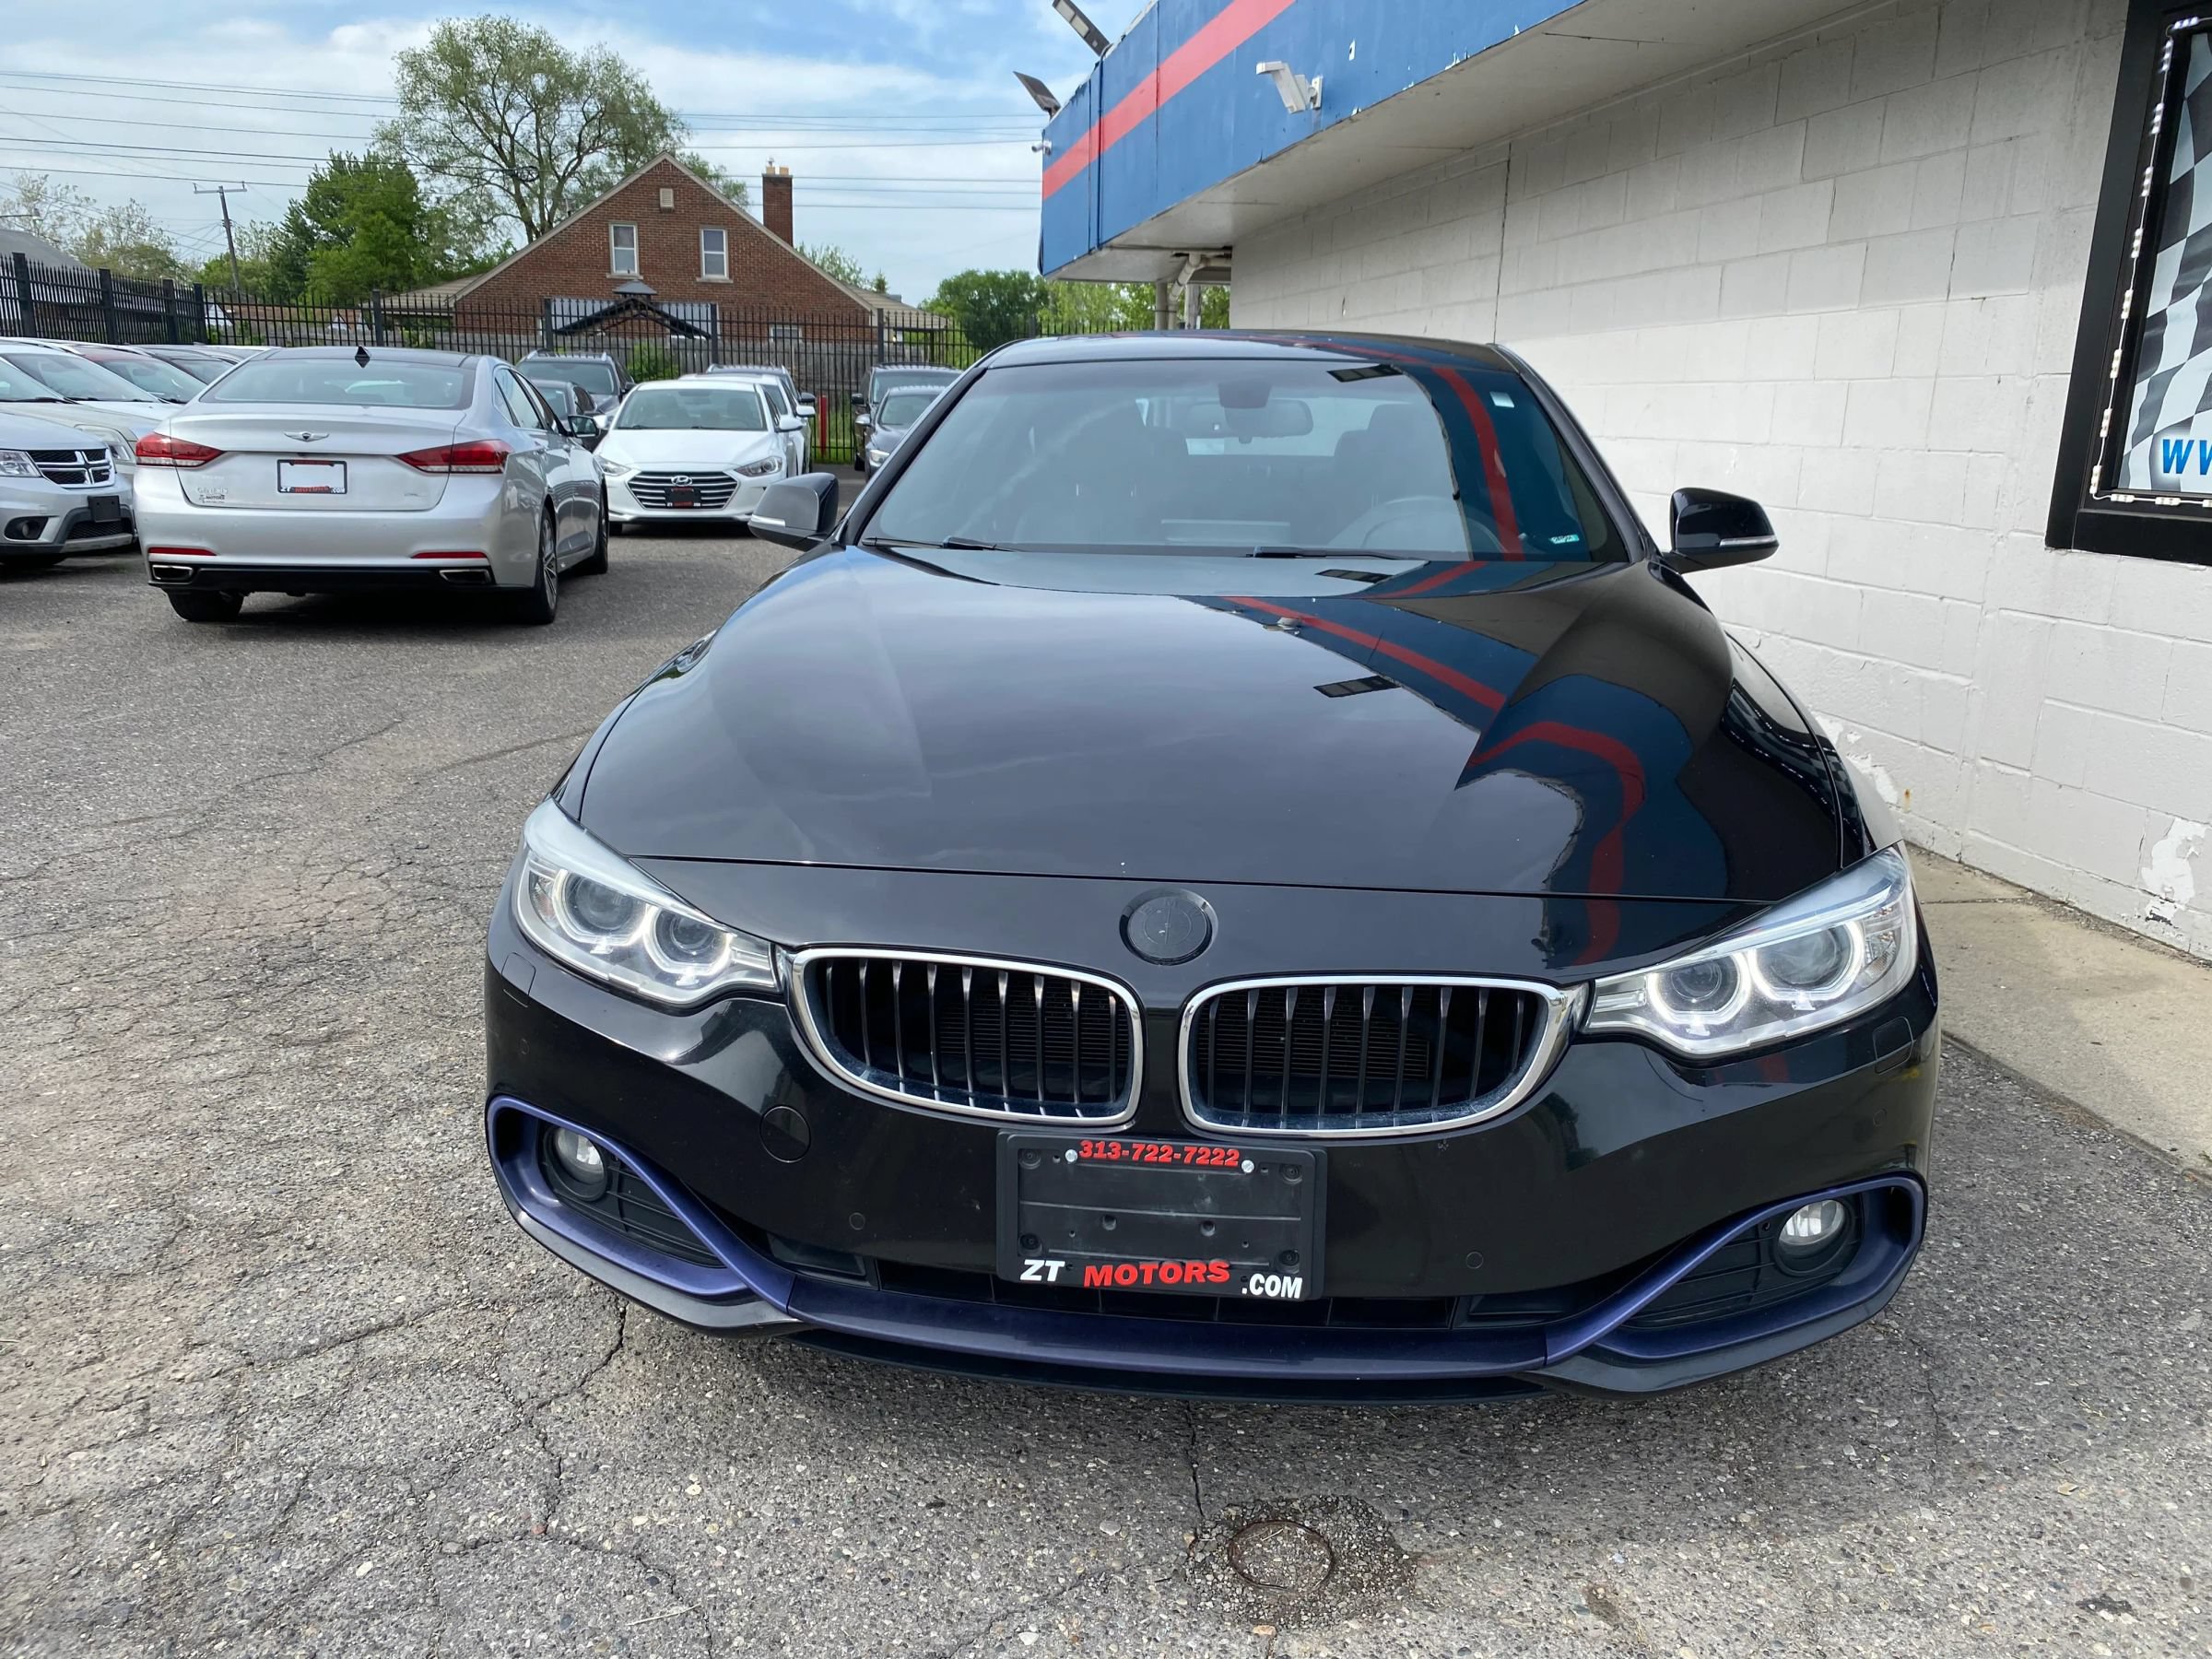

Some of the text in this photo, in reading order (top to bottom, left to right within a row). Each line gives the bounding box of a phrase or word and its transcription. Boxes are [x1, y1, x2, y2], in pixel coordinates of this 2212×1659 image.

[1079, 1140, 1240, 1167] 313-722-7222
[1019, 1259, 1303, 1300] ZT MOTORS .COM
